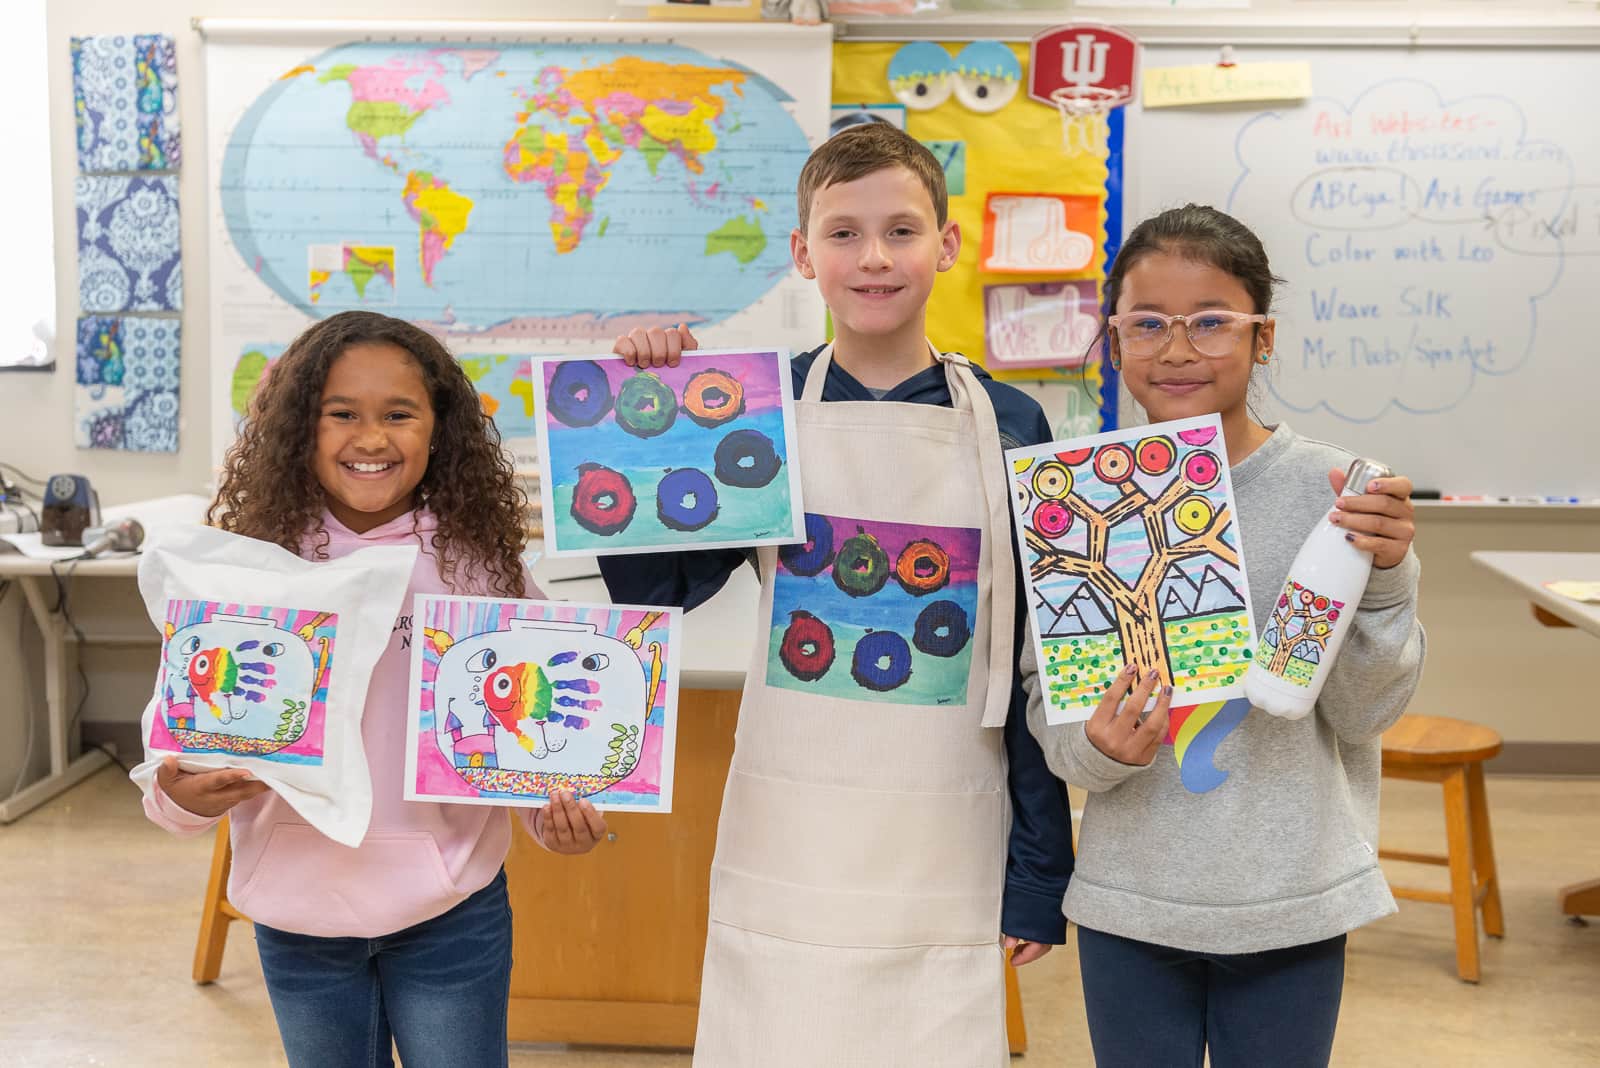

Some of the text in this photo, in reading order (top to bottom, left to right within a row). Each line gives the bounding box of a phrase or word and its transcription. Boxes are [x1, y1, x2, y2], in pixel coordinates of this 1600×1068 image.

[1423, 178, 1462, 208] Art
[1305, 232, 1495, 267] Color with Leo
[1311, 287, 1383, 321] Weave
